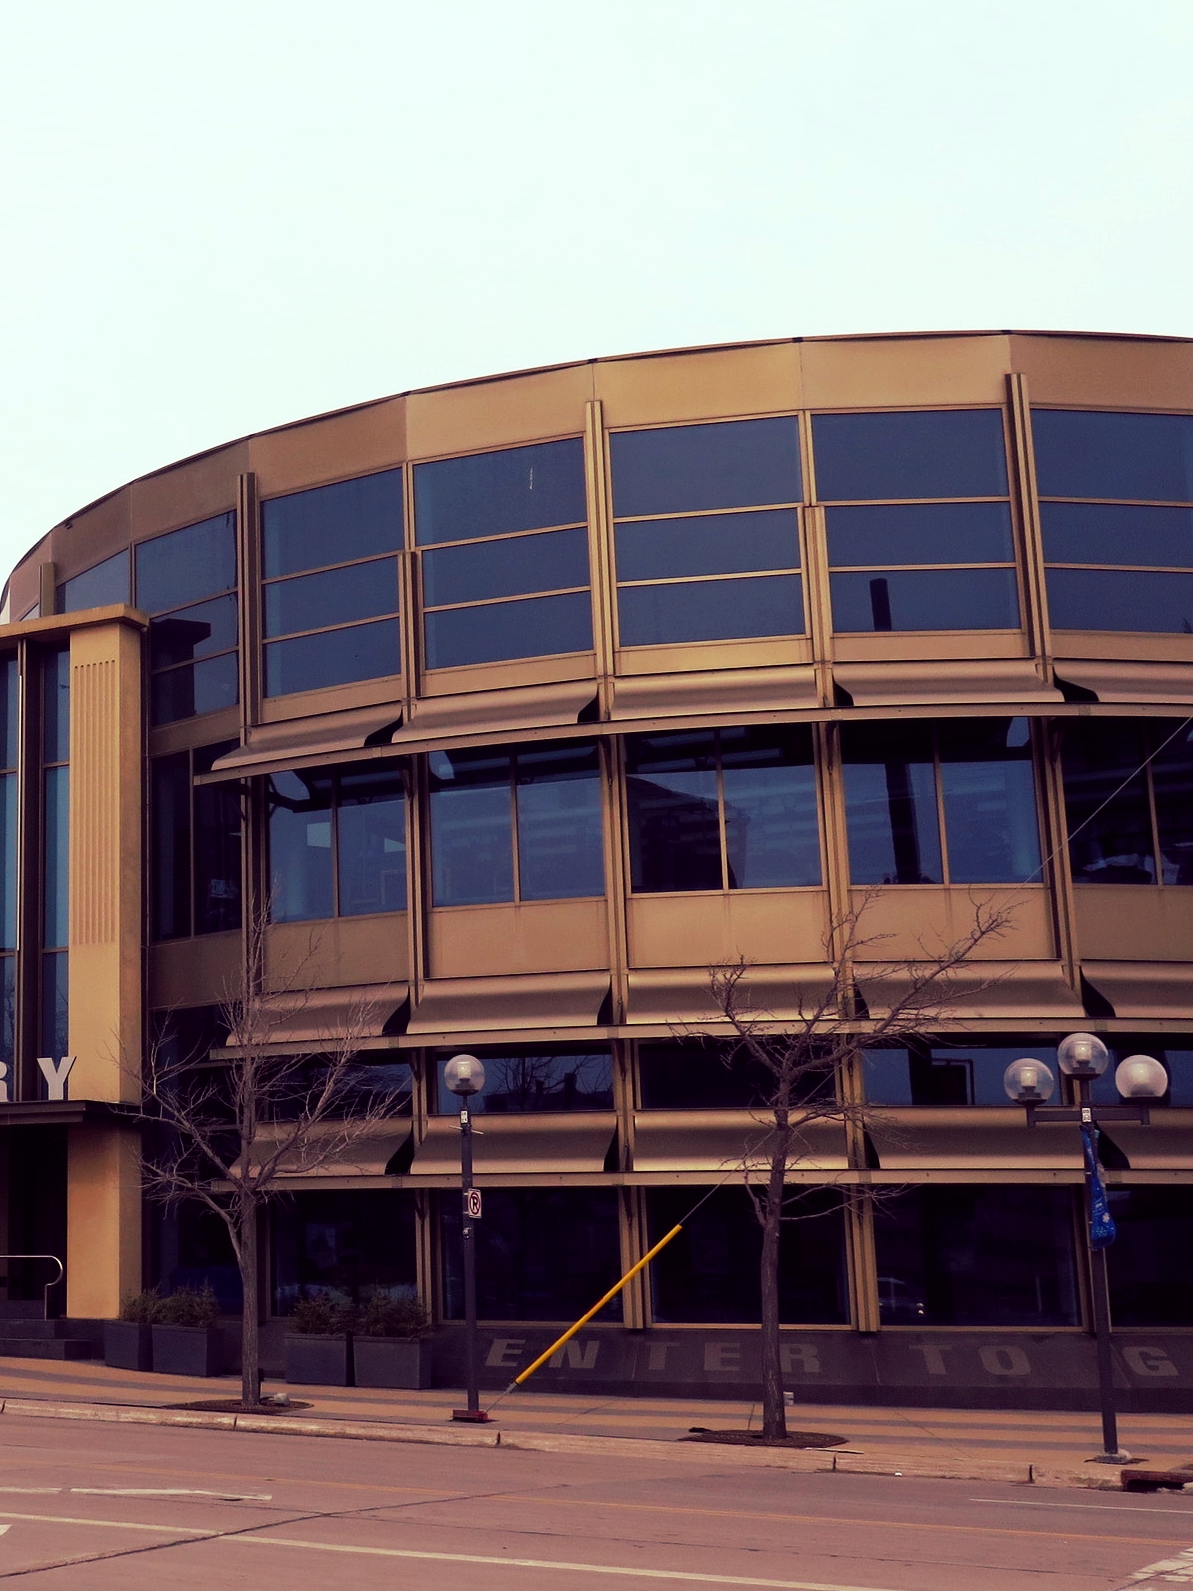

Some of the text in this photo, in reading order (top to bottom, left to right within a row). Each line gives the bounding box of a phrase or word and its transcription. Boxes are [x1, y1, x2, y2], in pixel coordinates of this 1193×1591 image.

[484, 1338, 1180, 1377] ENTER TO G
